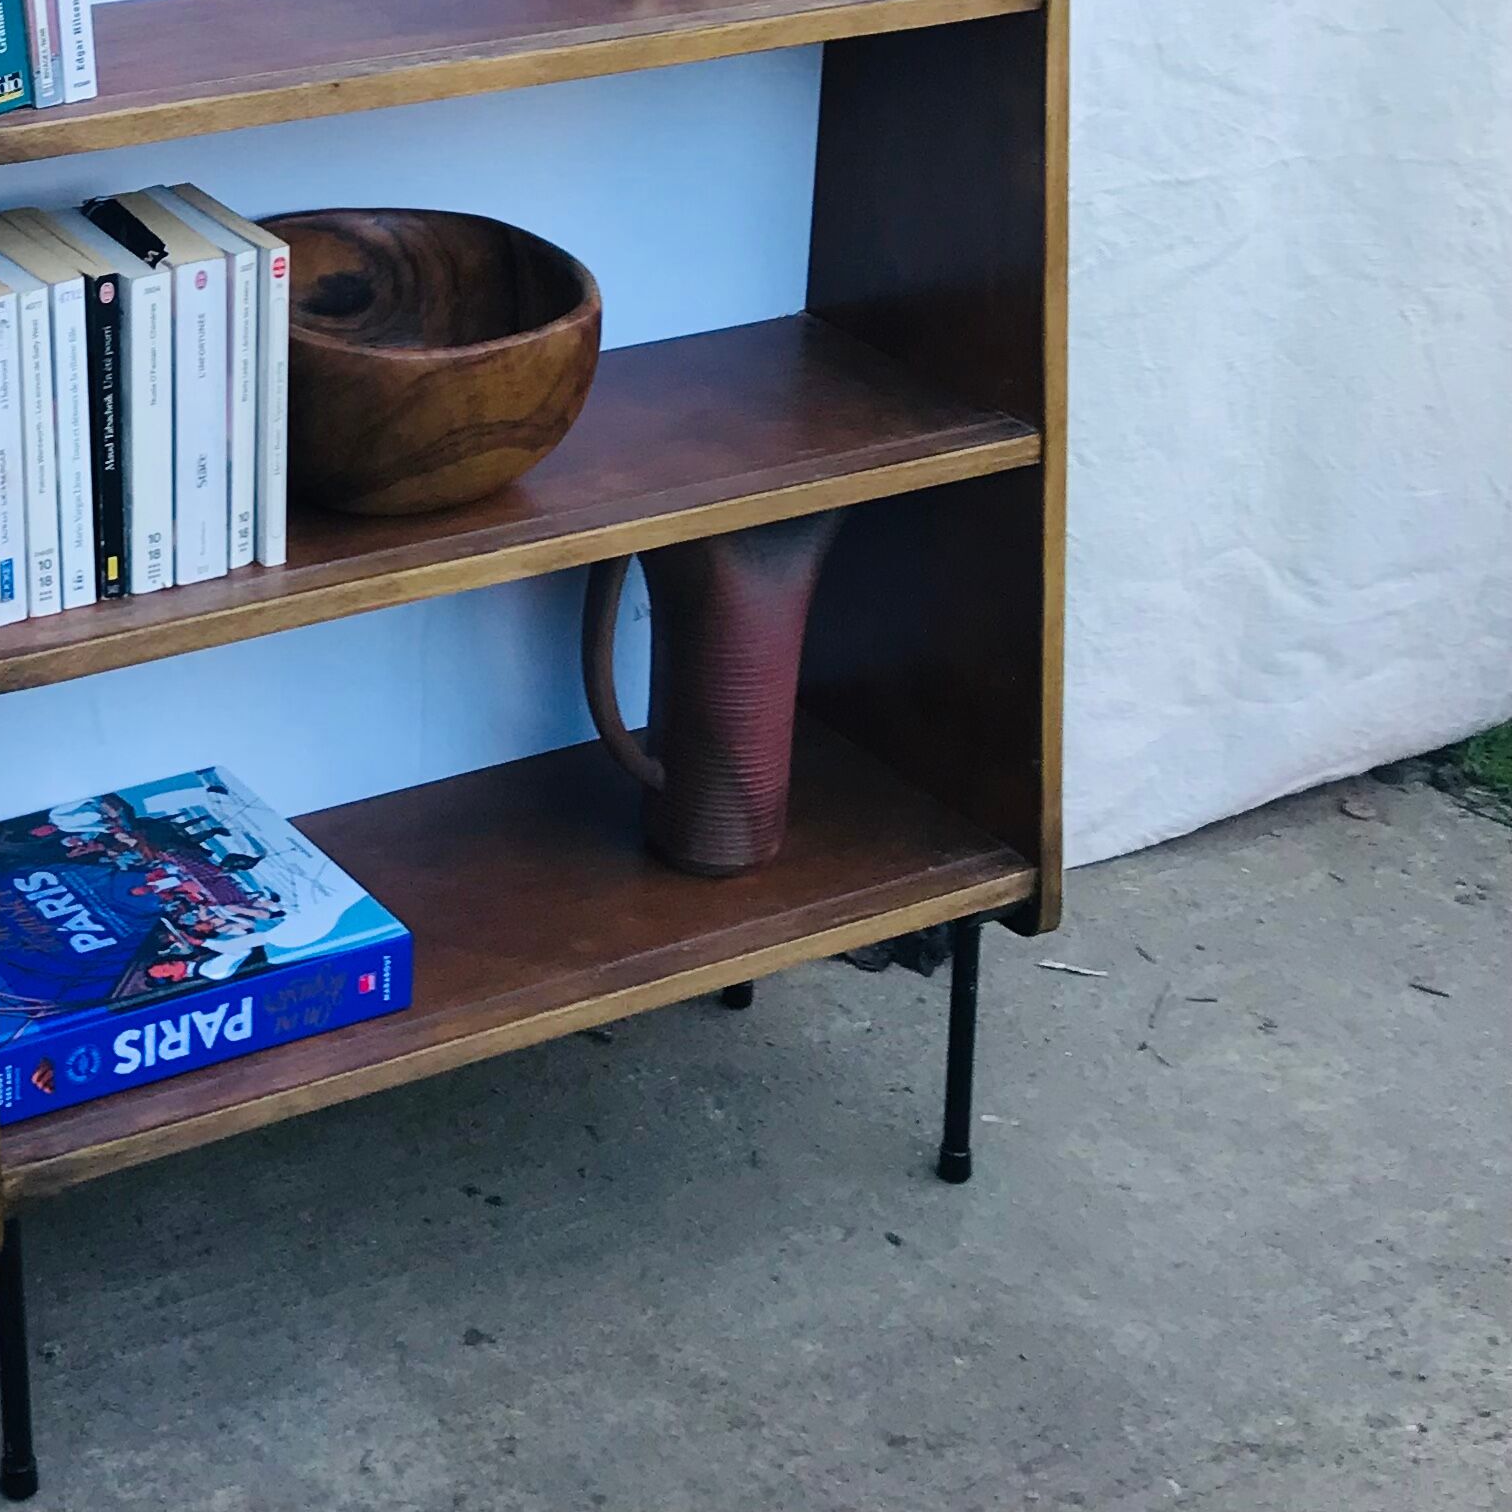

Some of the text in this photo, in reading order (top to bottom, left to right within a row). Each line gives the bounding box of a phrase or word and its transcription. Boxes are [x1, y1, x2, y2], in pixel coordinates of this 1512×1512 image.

[75, 40, 86, 71] Edgar
[102, 325, 115, 355] pourri
[102, 357, 113, 371] été
[102, 373, 113, 390] Un
[104, 442, 115, 471] Maud
[38, 558, 52, 571] 10
[148, 548, 162, 560] 18
[39, 574, 53, 587] 18
[13, 871, 118, 953] PARIS
[383, 955, 392, 1001] MARABOUT
[113, 996, 253, 1074] PARIS
